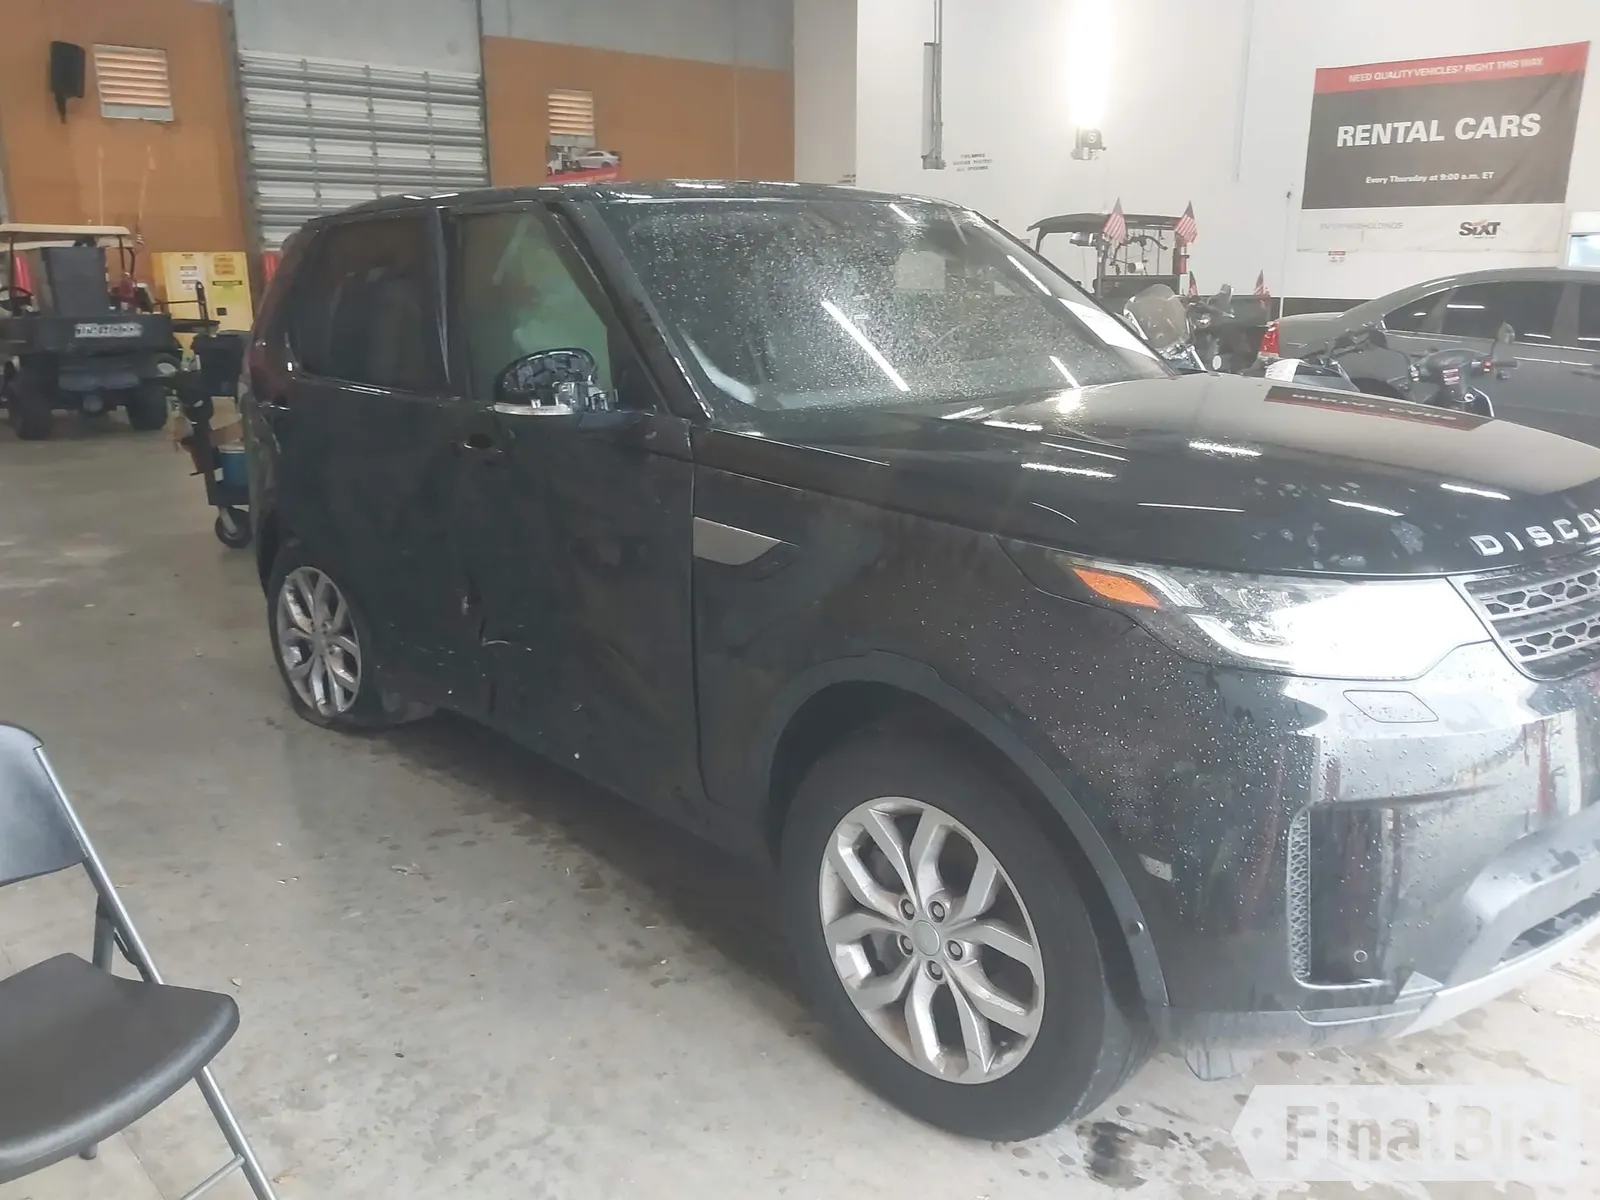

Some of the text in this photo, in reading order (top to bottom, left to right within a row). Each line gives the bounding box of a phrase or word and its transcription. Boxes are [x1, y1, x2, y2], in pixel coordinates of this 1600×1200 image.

[1348, 73, 1373, 82] NEED
[1373, 69, 1412, 80] QUALITY
[1413, 65, 1463, 77] VEHICLES?
[1465, 61, 1495, 72] RIGHT
[1497, 59, 1520, 69] THIS
[1337, 112, 1541, 147] RENTAL CARS
[1365, 176, 1388, 184] Every
[1390, 174, 1427, 183] Thursday
[1440, 173, 1459, 181] 9:00
[1482, 171, 1494, 179] ET
